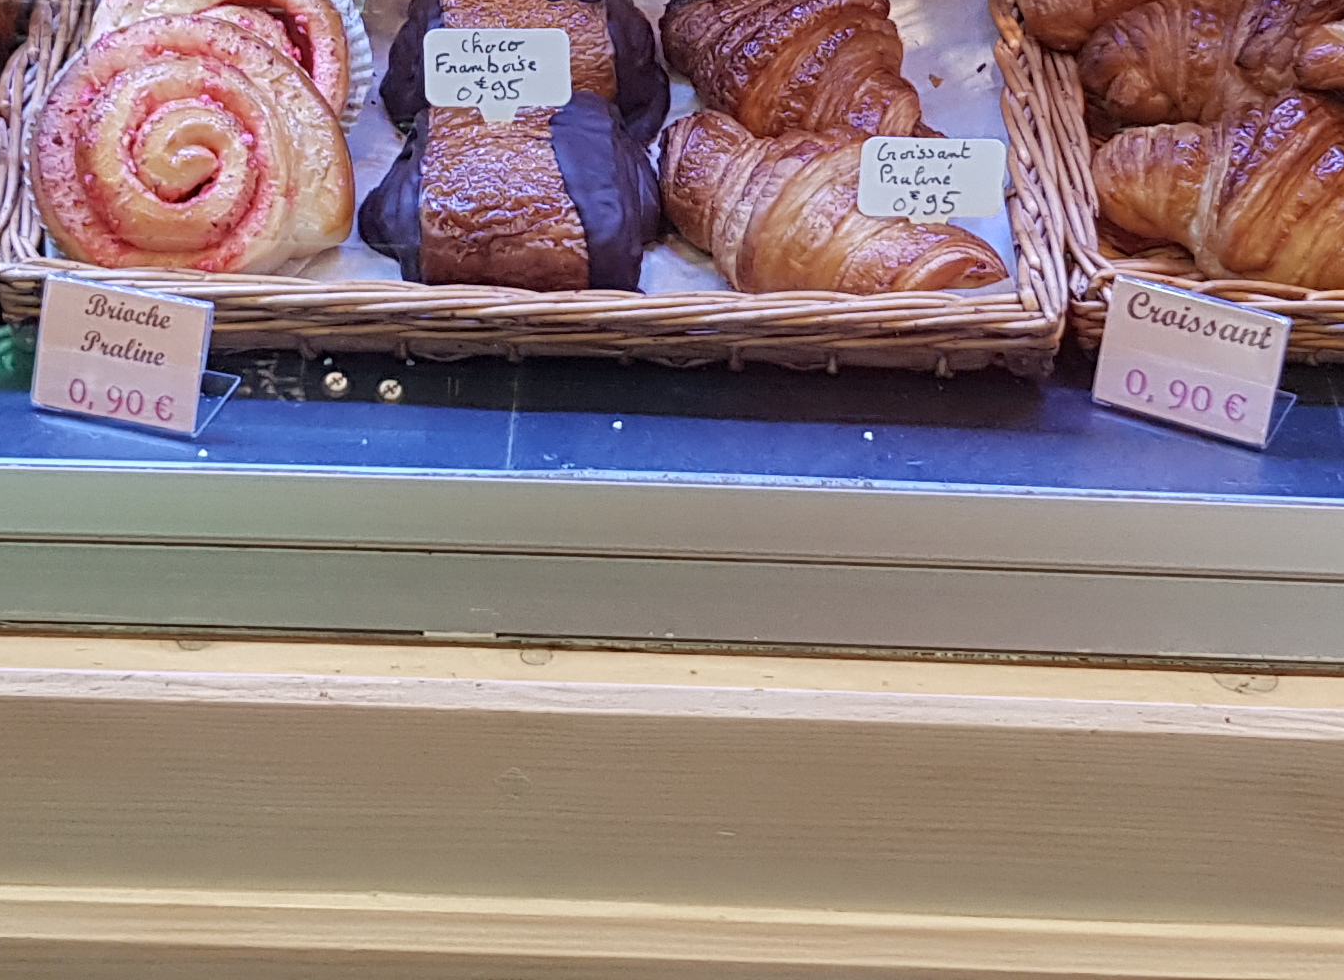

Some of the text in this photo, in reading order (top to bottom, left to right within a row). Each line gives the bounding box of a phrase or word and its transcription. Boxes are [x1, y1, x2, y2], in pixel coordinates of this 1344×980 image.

[435, 53, 537, 74] Framboise
[877, 141, 972, 162] Croissant
[880, 163, 953, 187] Praliné
[84, 293, 172, 330] Brioche
[1126, 291, 1273, 350] Croissant
[80, 330, 166, 367] Praline
